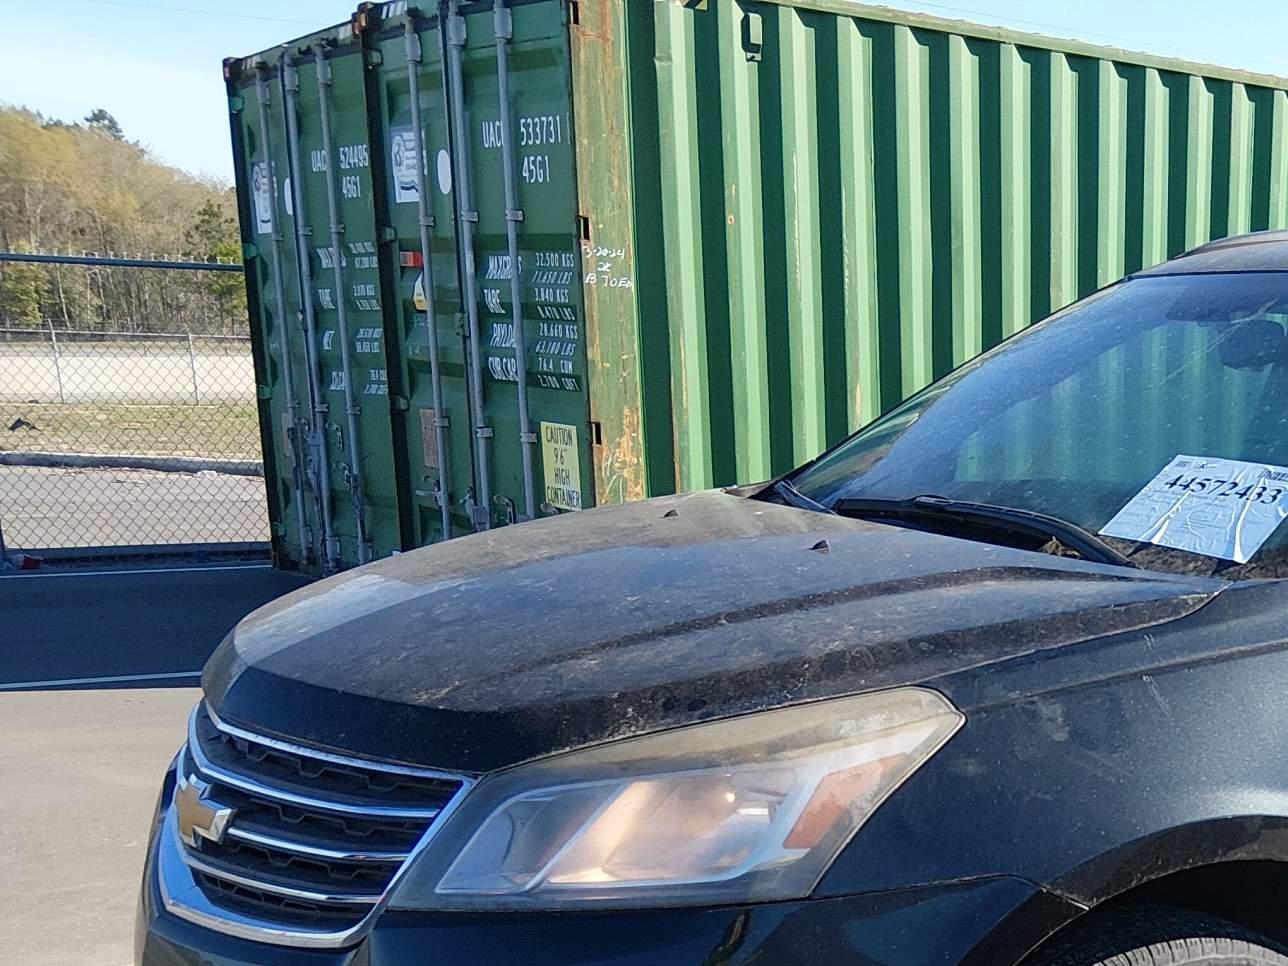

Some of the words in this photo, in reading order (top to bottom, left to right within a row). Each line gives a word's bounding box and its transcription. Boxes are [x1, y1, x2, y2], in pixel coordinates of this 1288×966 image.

[482, 121, 504, 148] UAC
[520, 115, 561, 146] 533731
[339, 144, 369, 169] 524495
[522, 155, 550, 183] 45G1
[535, 252, 559, 267] 32.500
[561, 253, 575, 267] KGS
[557, 271, 573, 284] LBS
[483, 288, 506, 314] TARE
[556, 288, 569, 303] KGS
[558, 307, 575, 320] LBS
[539, 322, 562, 338] 28.660
[565, 324, 578, 339] KGS
[561, 342, 576, 356] LBS
[560, 360, 573, 374] CUM
[545, 426, 573, 446] CAUTION
[554, 468, 571, 487] HIGH
[546, 486, 580, 508] CONTAINER
[1164, 474, 1282, 505] 44572433
